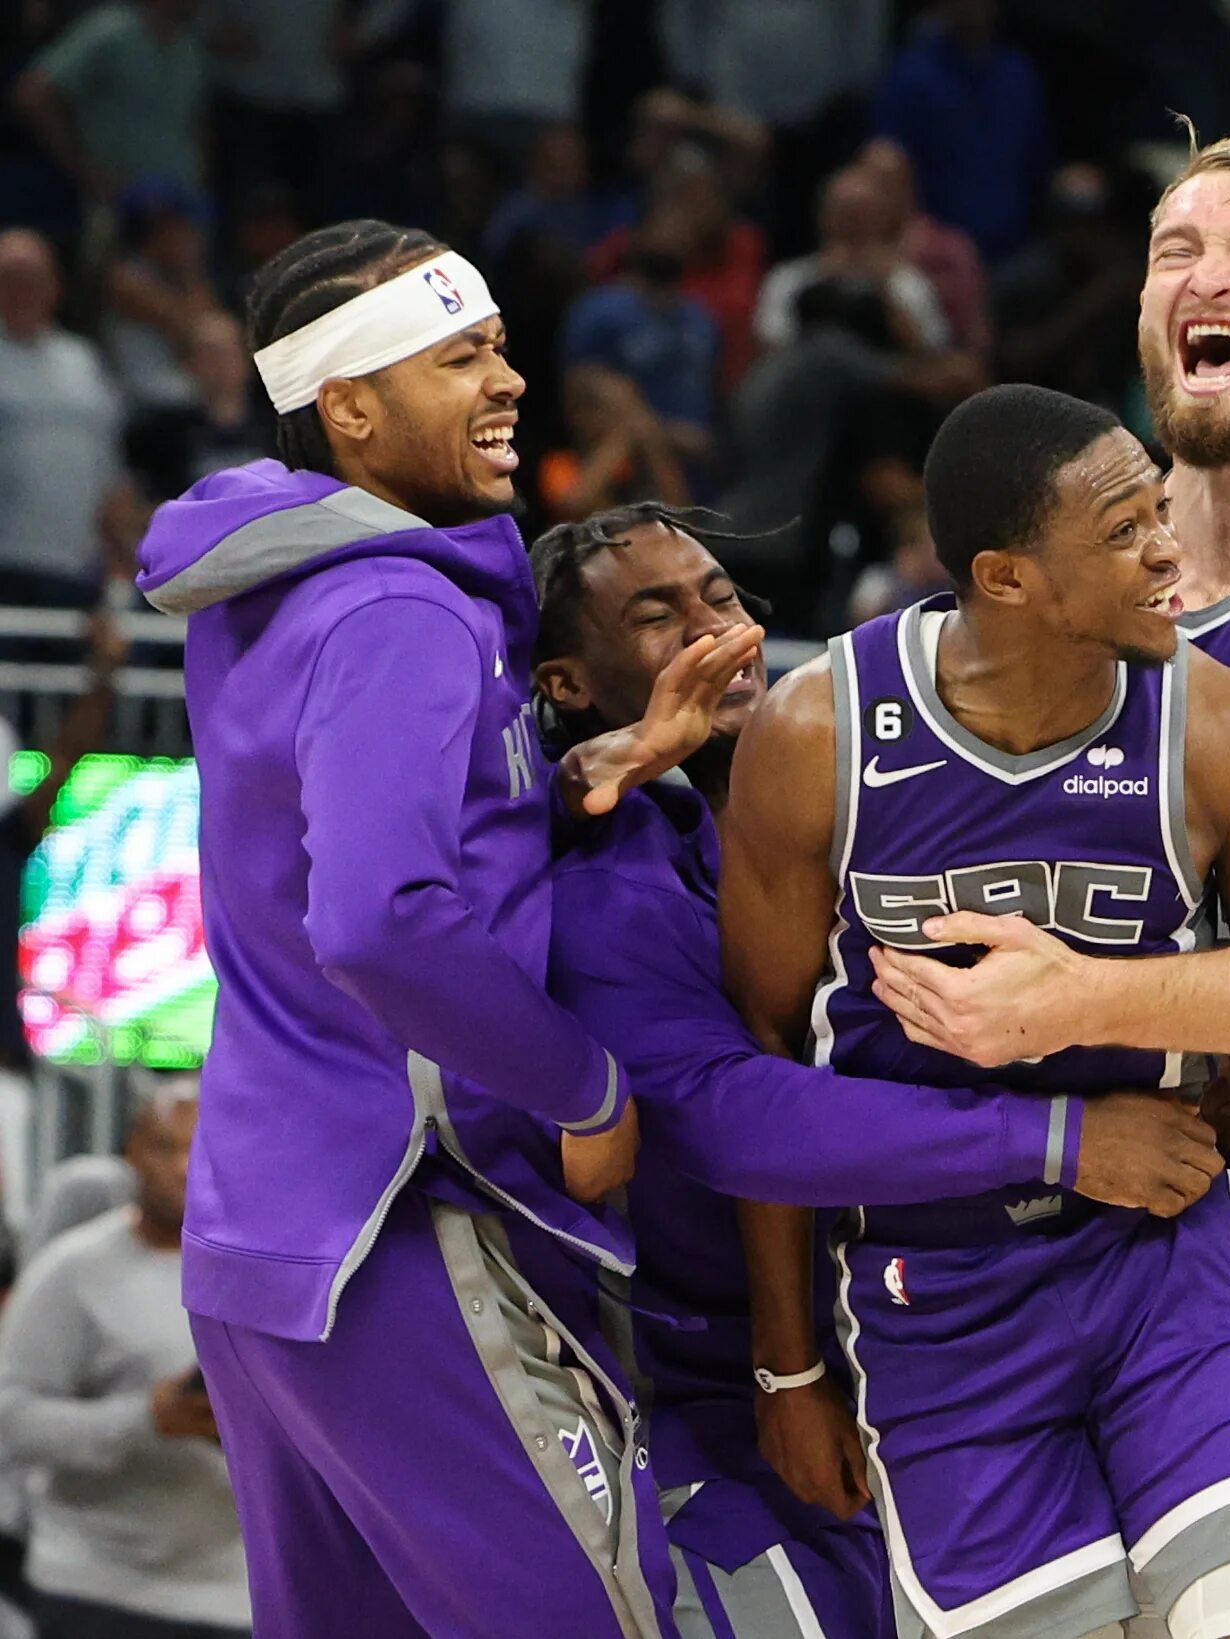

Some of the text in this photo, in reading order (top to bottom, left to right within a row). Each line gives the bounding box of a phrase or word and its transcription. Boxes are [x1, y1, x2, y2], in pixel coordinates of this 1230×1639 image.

[875, 702, 902, 740] 6
[1063, 775, 1148, 799] dialpad
[849, 860, 1152, 949] SAC
